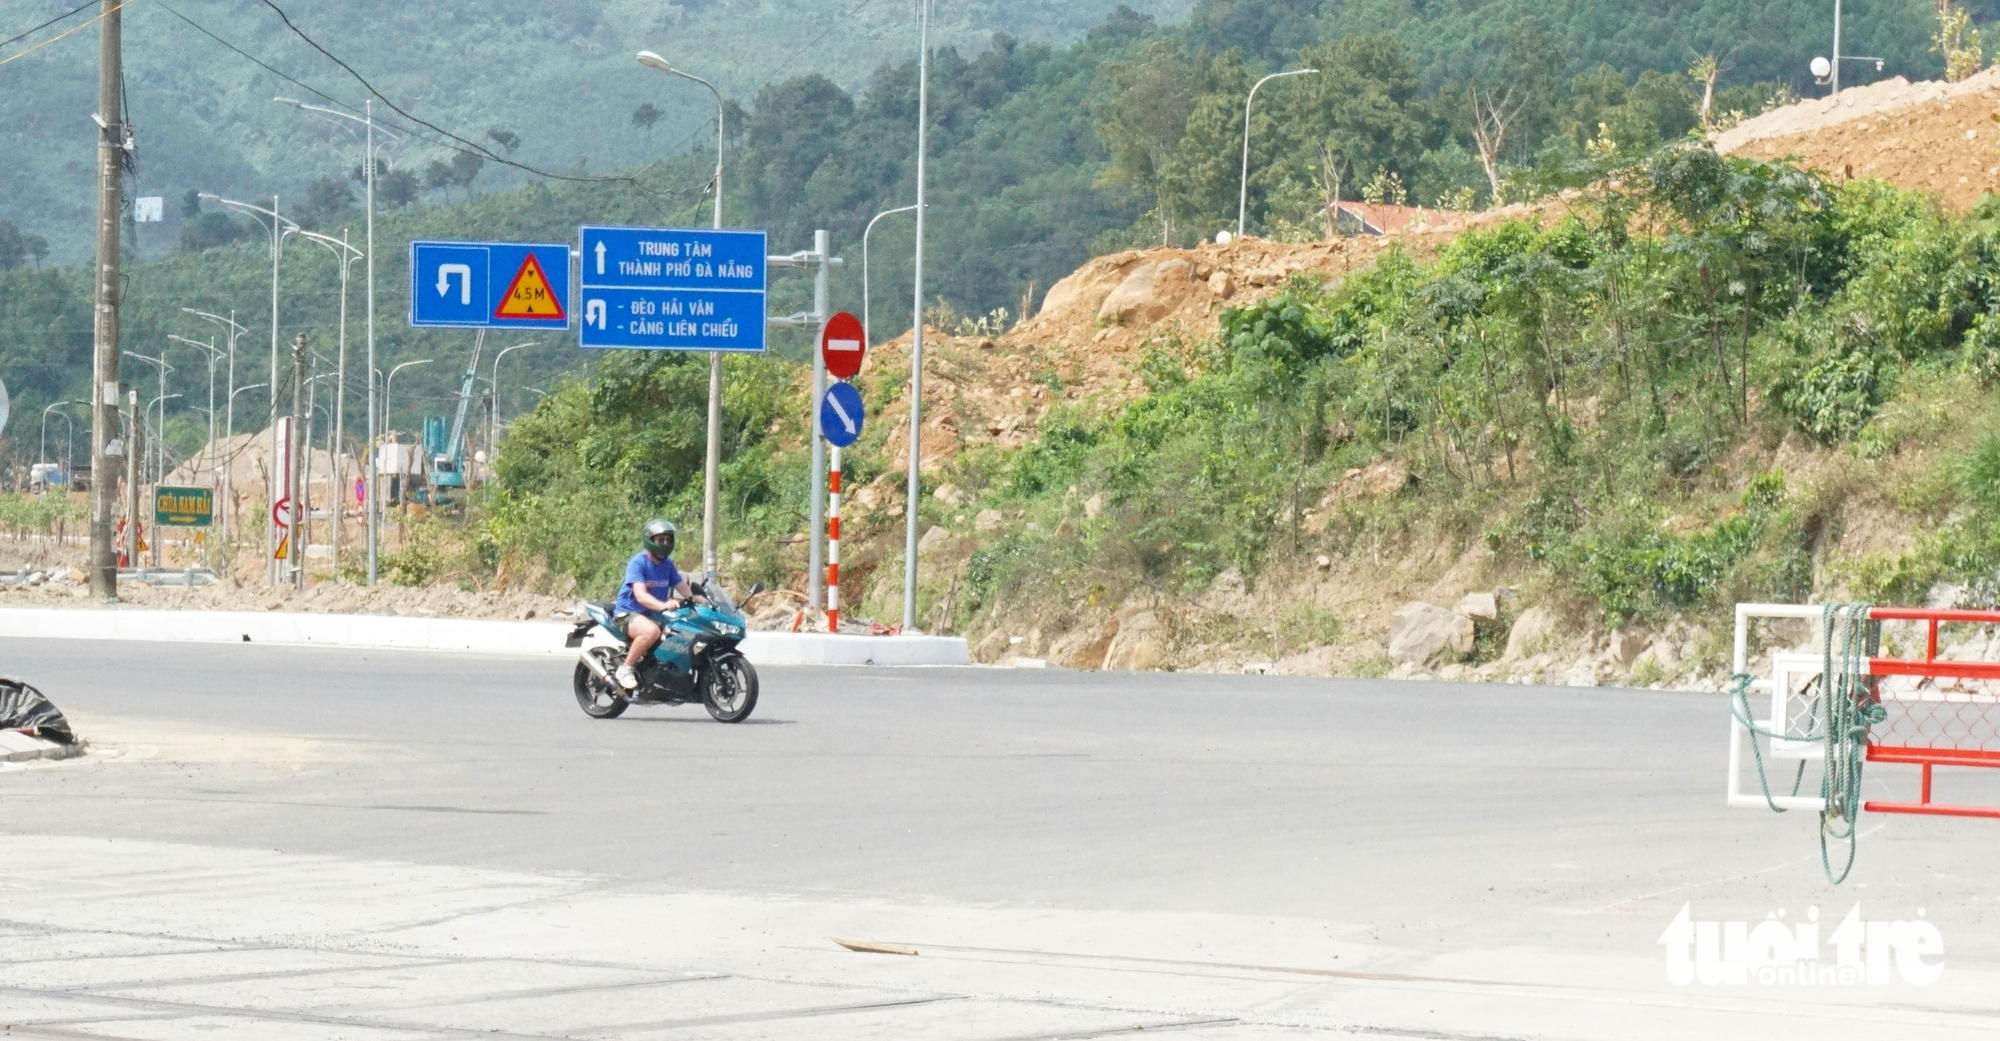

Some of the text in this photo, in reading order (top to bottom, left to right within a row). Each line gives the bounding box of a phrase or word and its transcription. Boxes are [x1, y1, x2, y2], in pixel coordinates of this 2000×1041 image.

[638, 240, 712, 258] TRUNG TÂM
[618, 258, 753, 279] THÀNH PHỐ ĐÀ NẴNG
[630, 297, 655, 315] ĐÈO
[661, 297, 683, 316] HẢI
[688, 299, 714, 316] VÂN
[630, 317, 664, 336] CẢNG
[668, 319, 697, 337] LIÊN
[702, 317, 738, 338] CHIỂU
